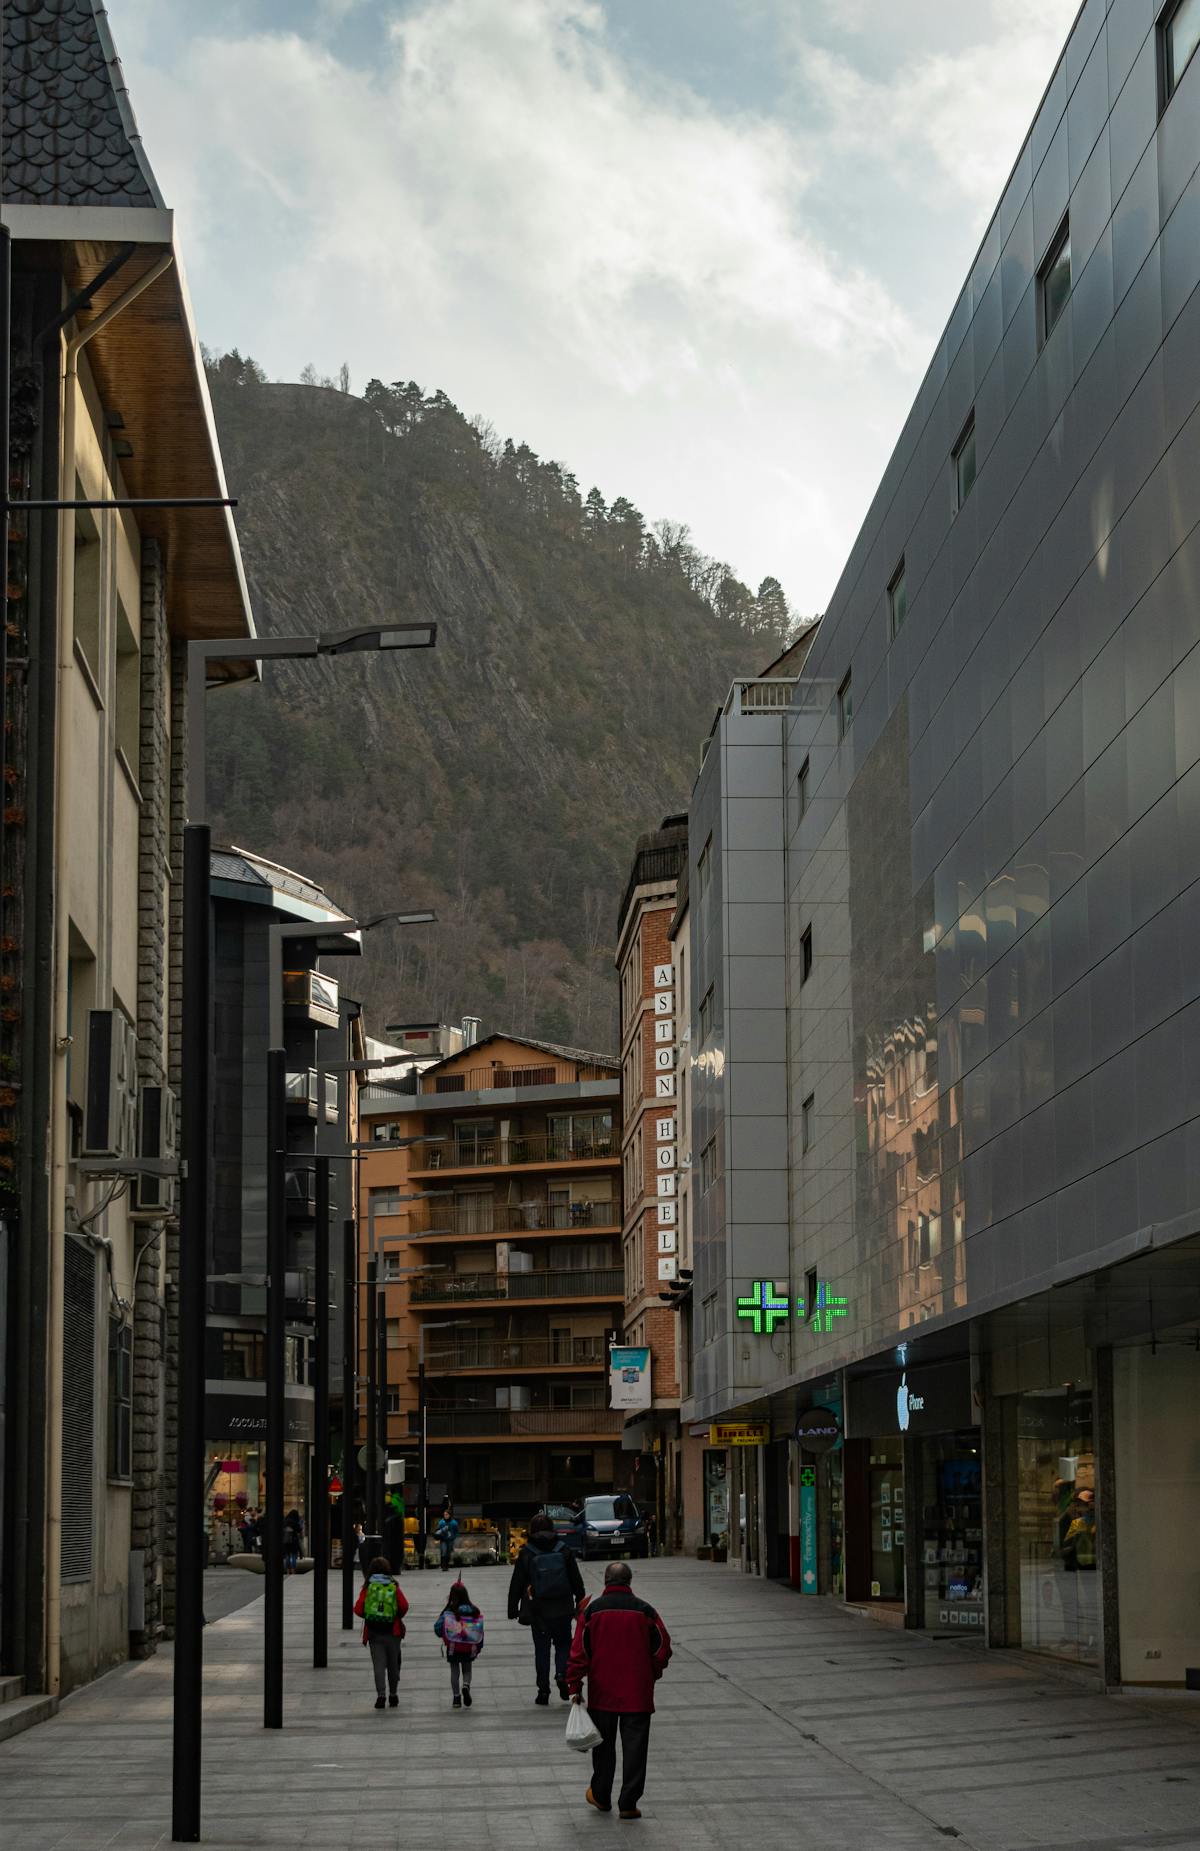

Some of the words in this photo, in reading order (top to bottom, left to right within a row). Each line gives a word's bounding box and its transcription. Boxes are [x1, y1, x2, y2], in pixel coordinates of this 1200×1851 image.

[657, 969, 671, 1094] ASTON
[660, 1122, 673, 1250] HOTEL
[908, 1393, 924, 1411] iPhone
[717, 1425, 764, 1437] PIRELLI
[798, 1426, 838, 1437] LAND
